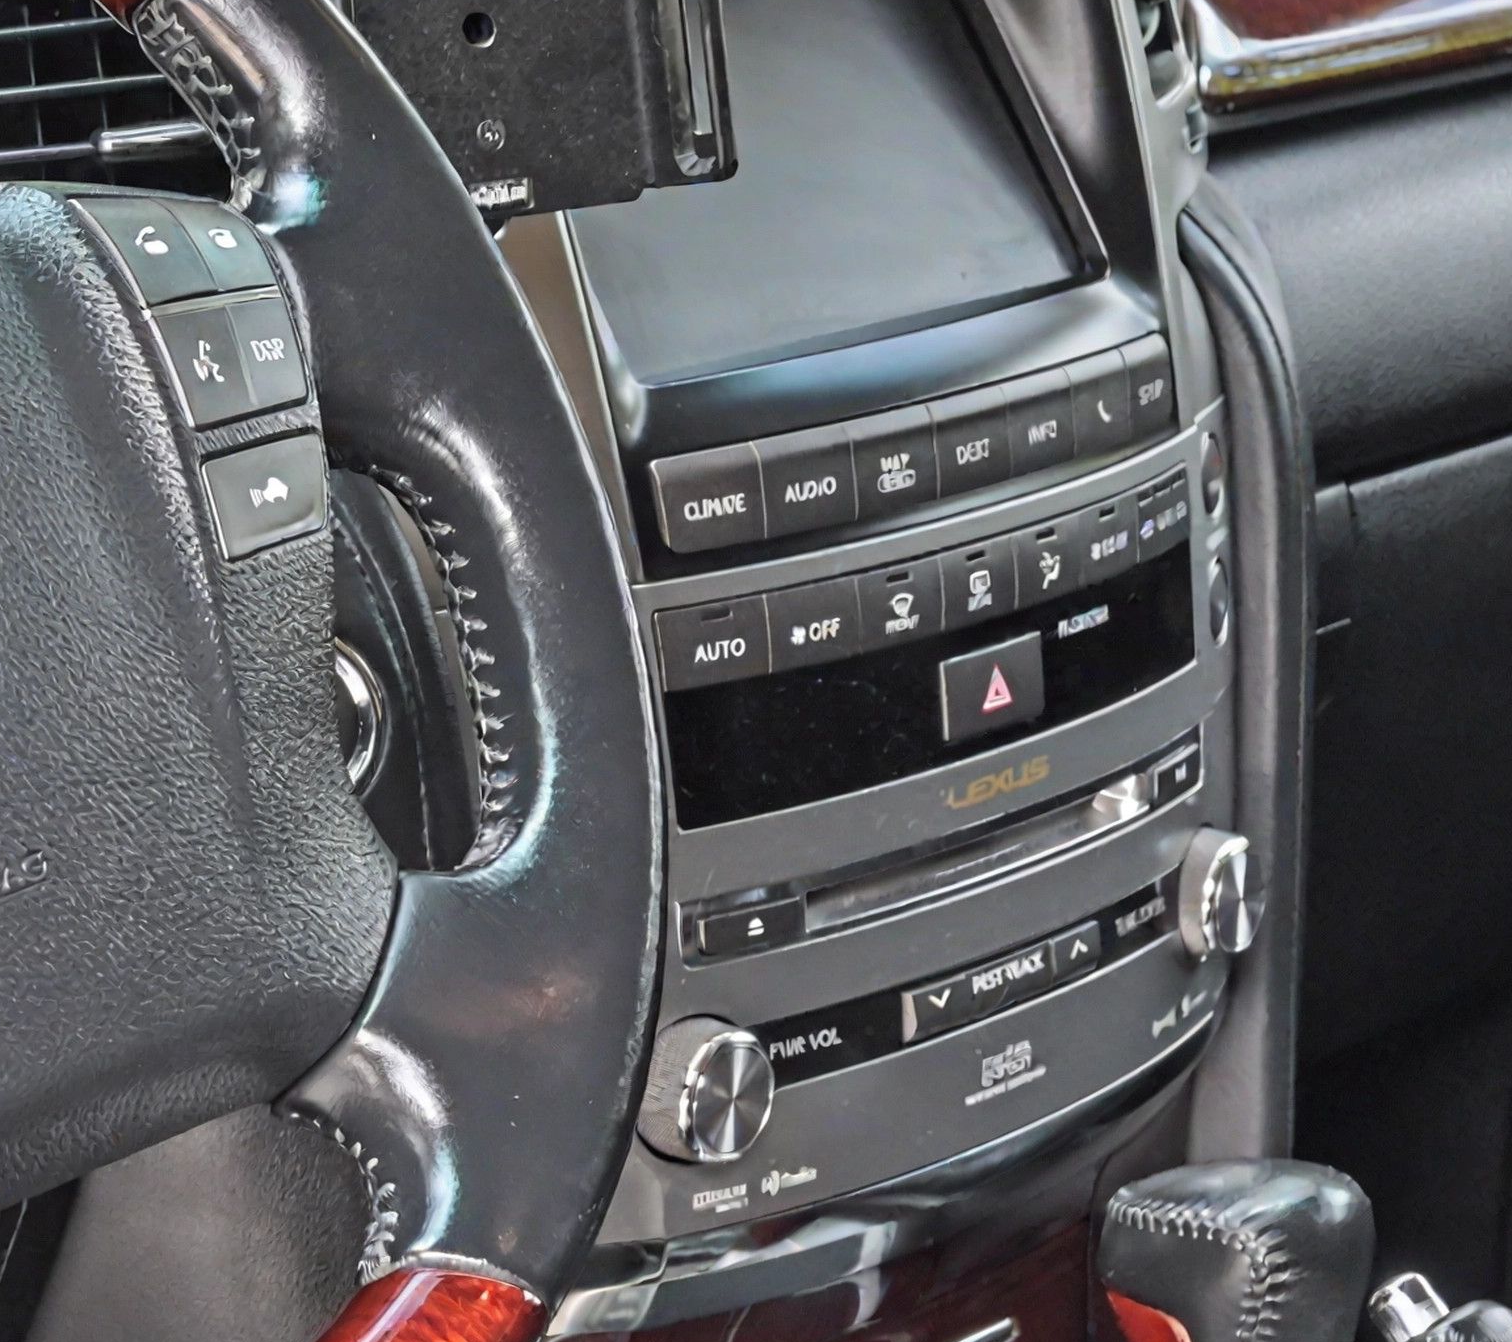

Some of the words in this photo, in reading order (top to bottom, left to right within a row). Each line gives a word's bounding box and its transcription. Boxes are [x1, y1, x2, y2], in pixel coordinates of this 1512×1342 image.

[784, 476, 837, 503] AUDIO
[684, 492, 747, 521] CLIMATE
[809, 617, 841, 642] OFF
[694, 637, 746, 663] AUTO
[946, 755, 1051, 809] LEXUS
[809, 1027, 843, 1050] VOL
